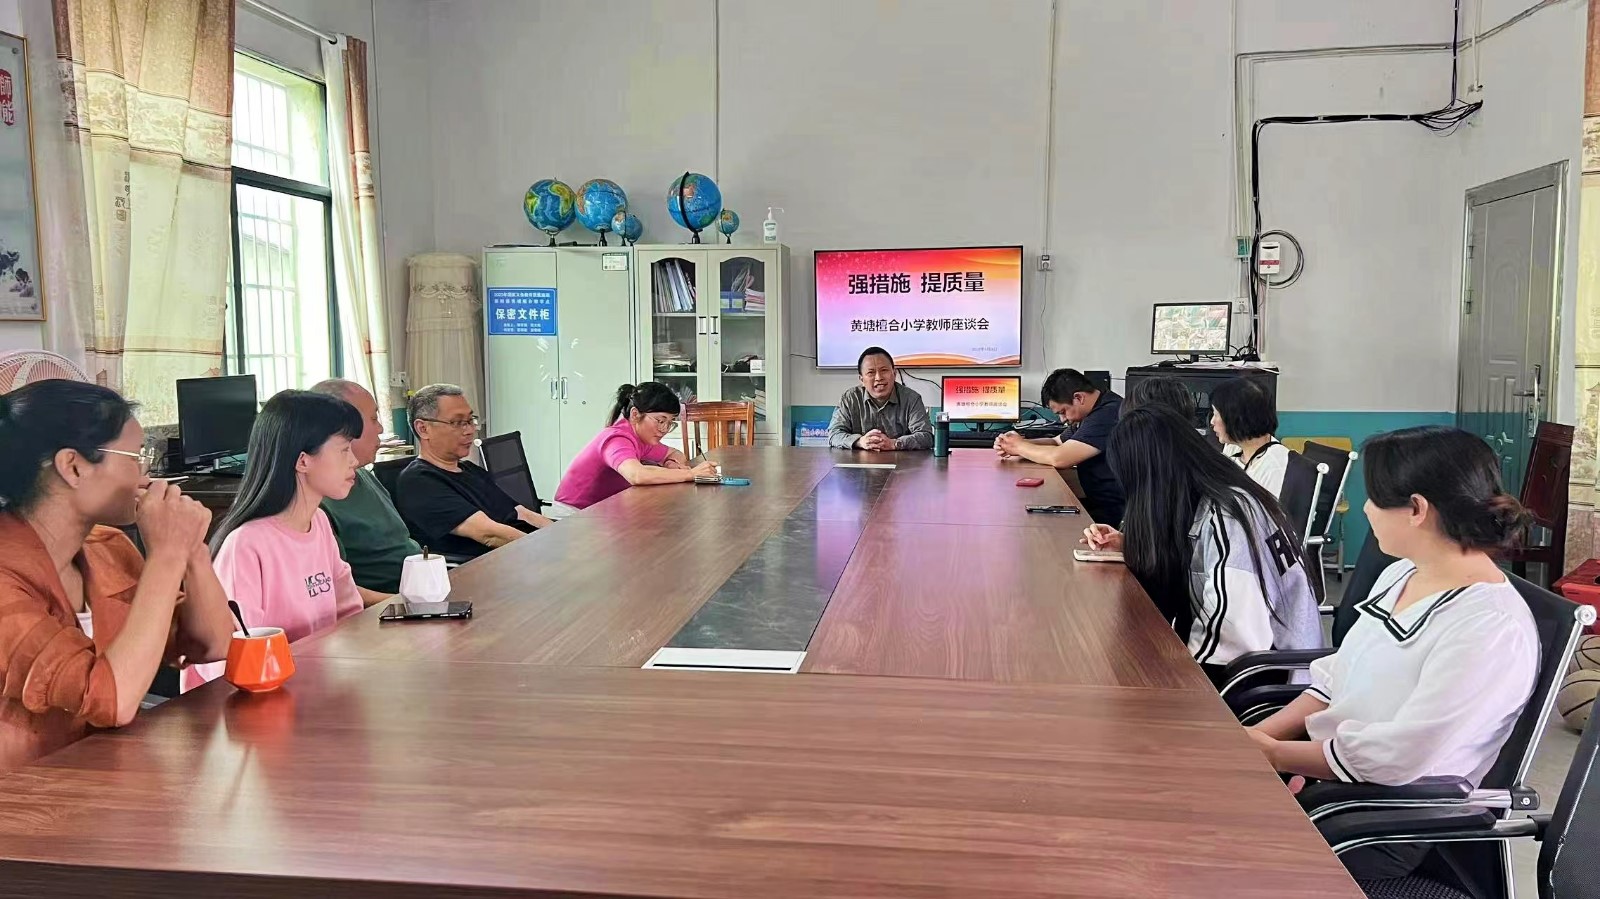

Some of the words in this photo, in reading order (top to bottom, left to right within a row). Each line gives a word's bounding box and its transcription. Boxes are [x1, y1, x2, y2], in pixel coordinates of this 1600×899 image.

[849, 273, 911, 294] 强措施
[921, 272, 985, 293] 提质量
[495, 308, 550, 320] 保密文件柜
[850, 318, 990, 332] 黄塘檀合小学教师座谈会
